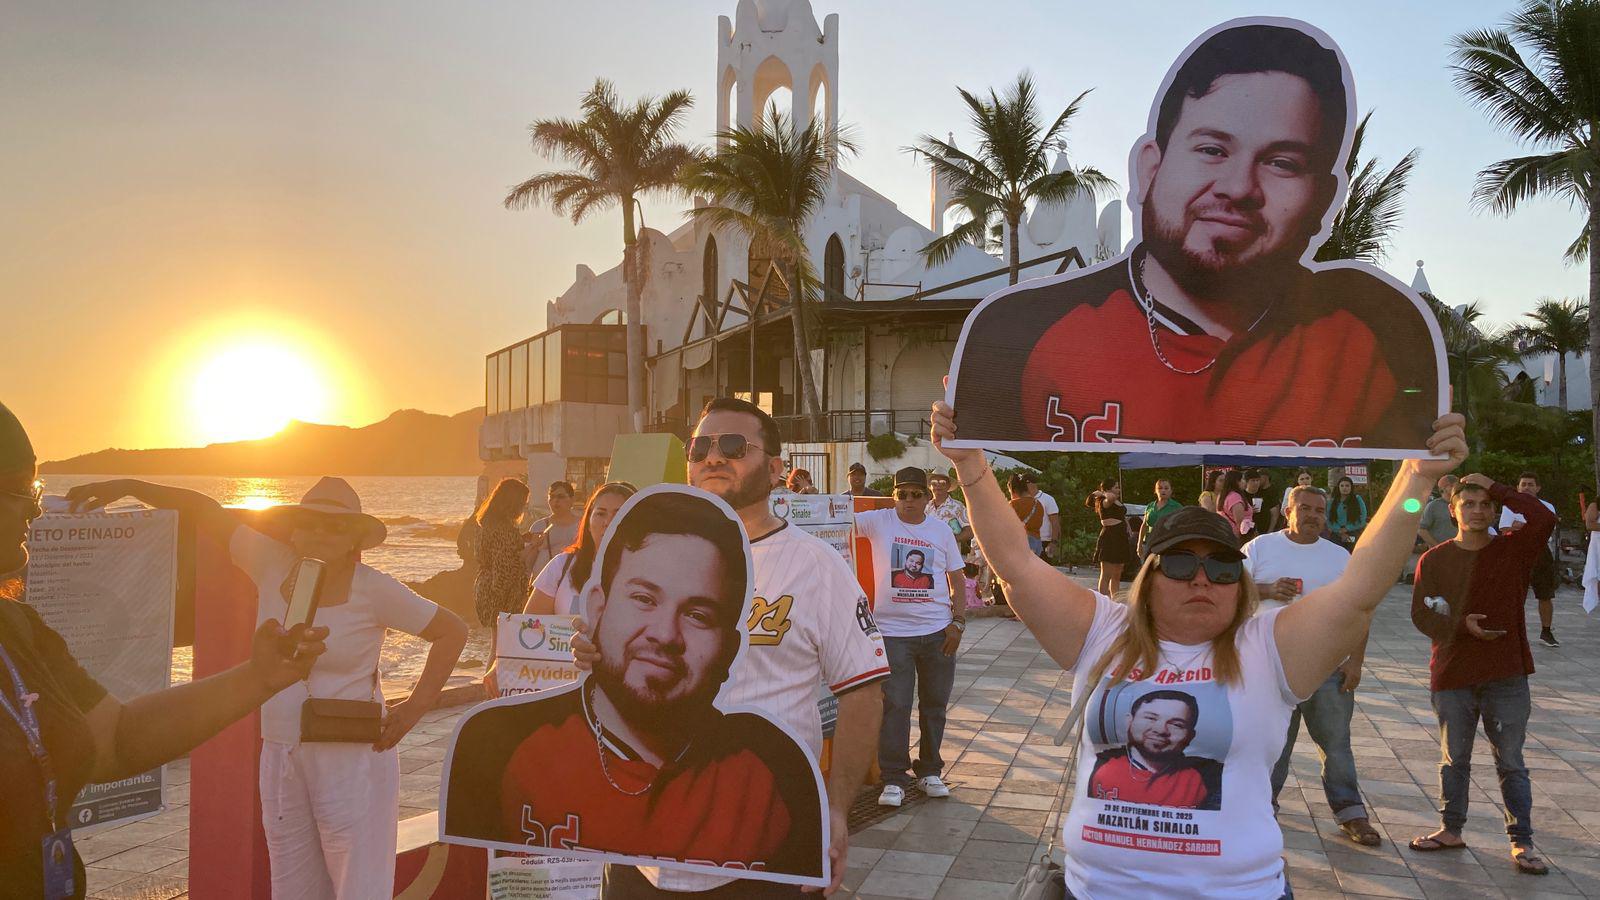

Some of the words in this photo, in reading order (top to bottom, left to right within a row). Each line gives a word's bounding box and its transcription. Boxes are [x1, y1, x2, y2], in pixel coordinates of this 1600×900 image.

[68, 527, 136, 540] PEINADO
[548, 637, 573, 652] Sin
[90, 774, 155, 793] importante.
[1121, 806, 1159, 817] SEPTIEMBRE
[1162, 811, 1173, 819] DEL
[1176, 812, 1193, 820] 2025
[1097, 813, 1149, 831] MAZATLÁN
[1153, 821, 1200, 835] SINALOA
[1083, 829, 1103, 840] VICTOR
[1104, 832, 1133, 847] MANUEL
[1136, 837, 1184, 852] HERNÁNDEZ
[1185, 842, 1220, 853] SARABIA
[520, 858, 545, 866] Cédula:
